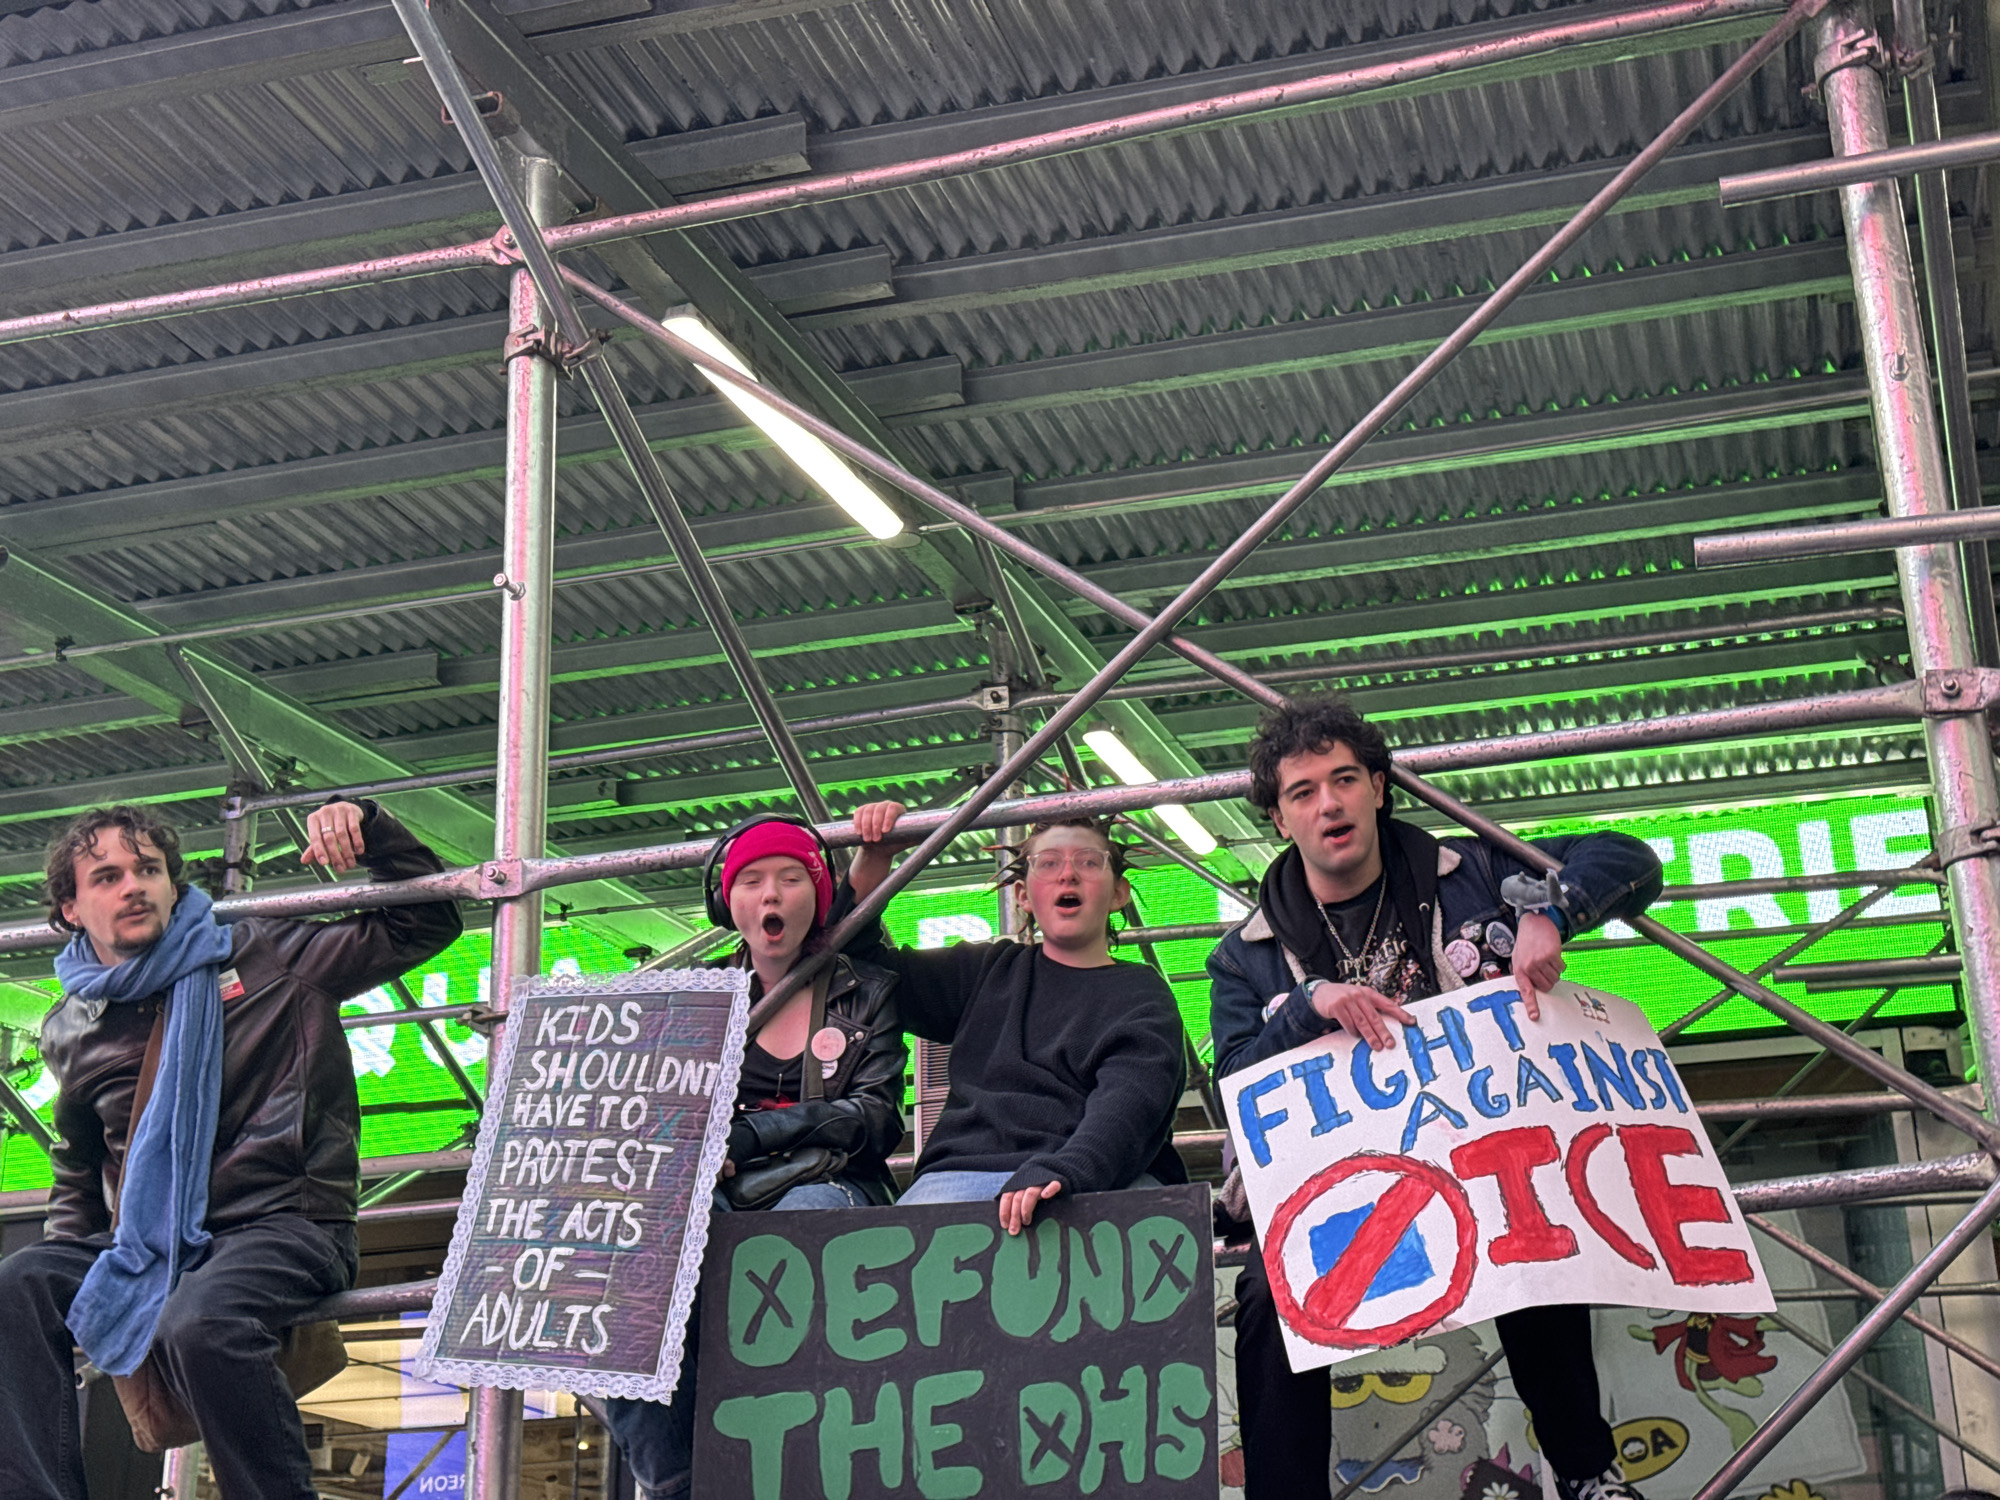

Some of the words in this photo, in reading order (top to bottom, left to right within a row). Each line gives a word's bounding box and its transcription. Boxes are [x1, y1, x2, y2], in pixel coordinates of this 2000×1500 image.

[535, 1001, 643, 1047] KIDS
[523, 1049, 720, 1097] SHOULDNT
[1237, 989, 1525, 1168] FIGHT
[1400, 1039, 1690, 1154] AGAINST
[512, 1092, 593, 1129] HAVE
[600, 1095, 648, 1131] TO
[499, 1137, 674, 1191] PROTEST
[486, 1198, 550, 1240] THE
[559, 1199, 644, 1248] ACTS
[1449, 1122, 1755, 1286] ICE
[727, 1215, 1199, 1368] DEFUND
[459, 1291, 613, 1354] ADULTS
[713, 1370, 985, 1500] THE
[1019, 1362, 1213, 1495] DHS
[1619, 1427, 1680, 1466] OA
